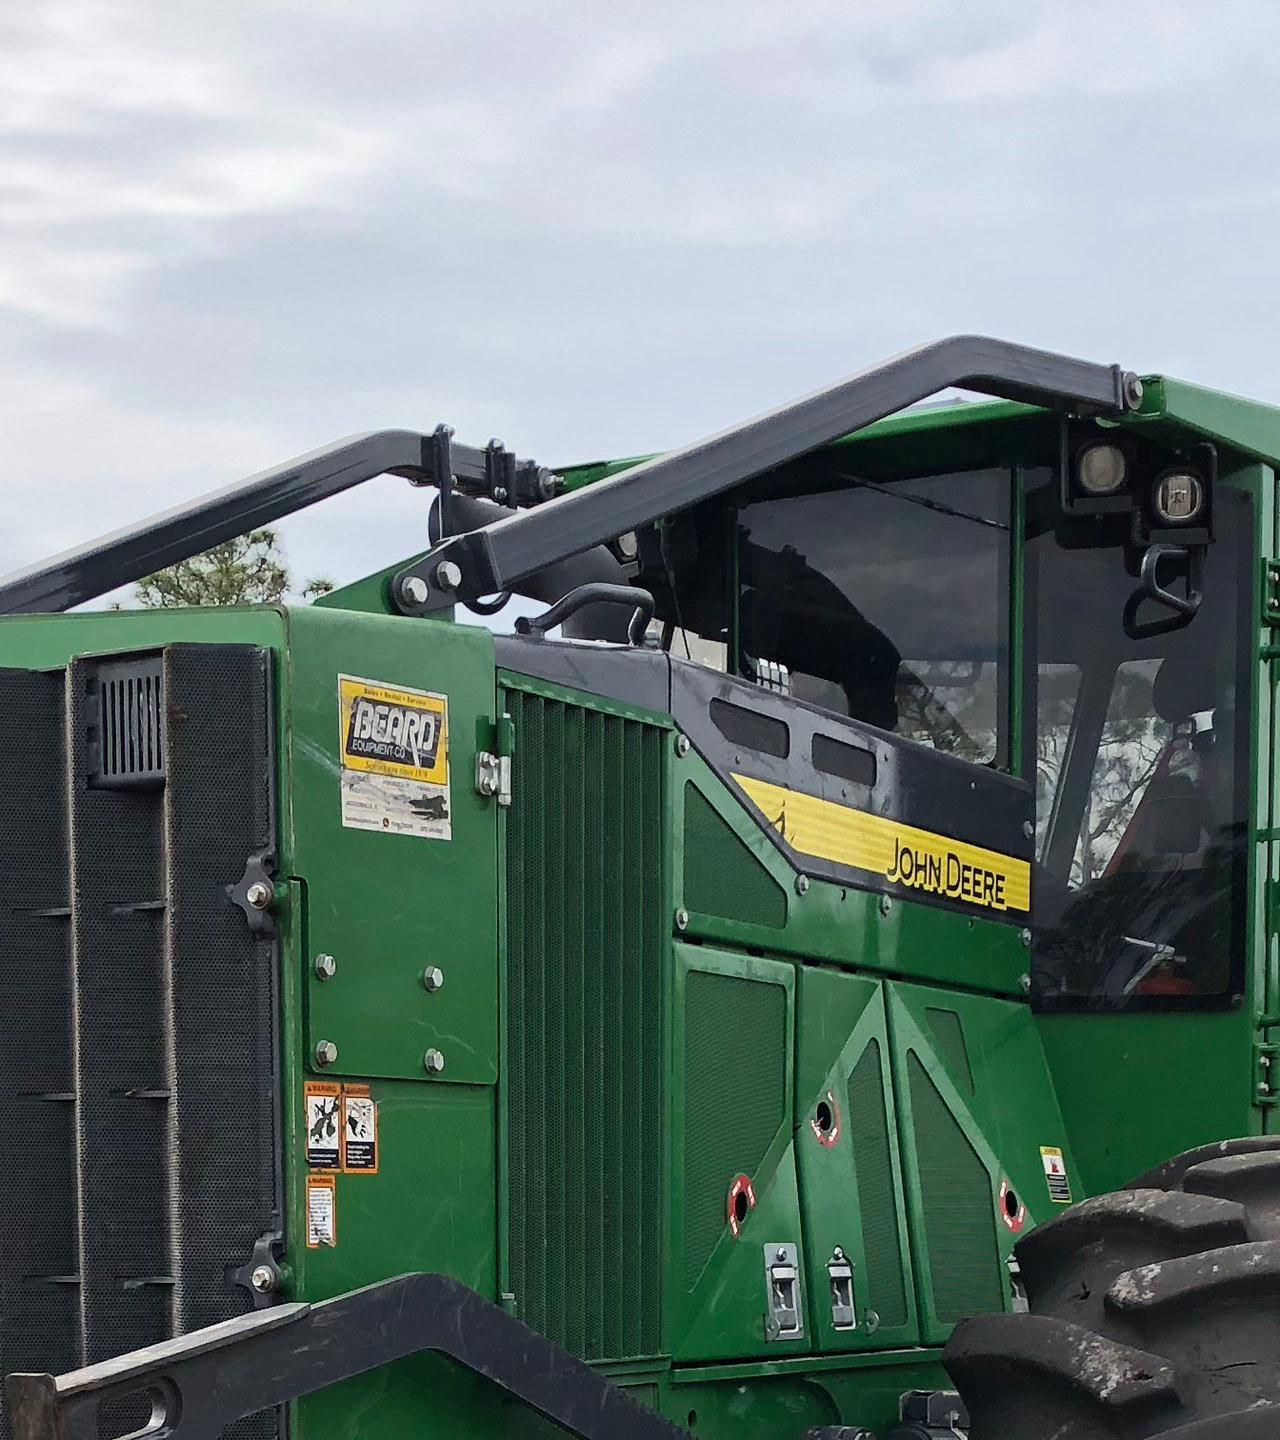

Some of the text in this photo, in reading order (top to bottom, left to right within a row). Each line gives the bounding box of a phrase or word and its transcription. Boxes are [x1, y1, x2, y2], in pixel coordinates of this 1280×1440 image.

[352, 738, 394, 757] EQUIPMENT
[353, 701, 435, 768] BEARD
[887, 837, 1006, 905] JOHN DEERE
